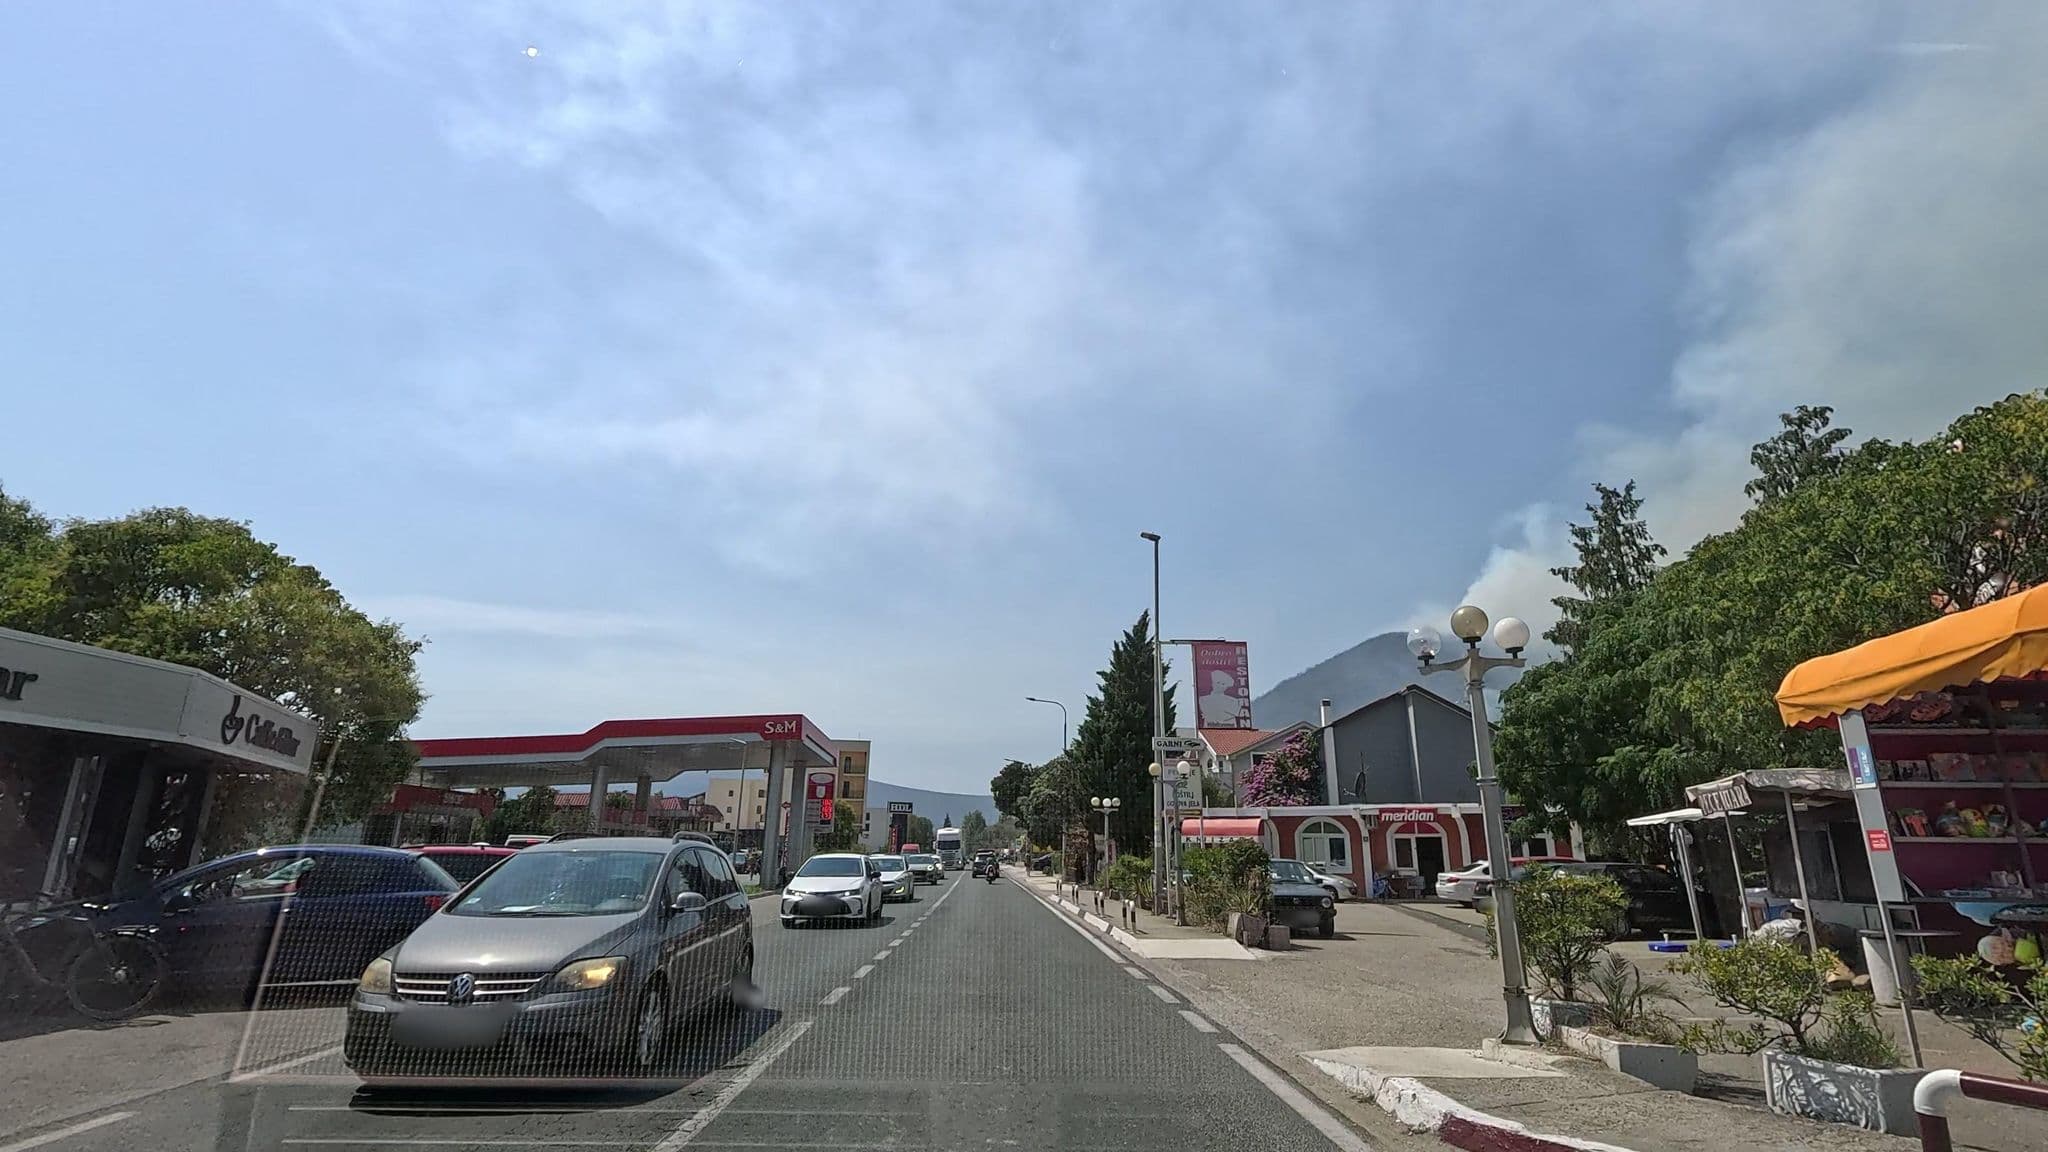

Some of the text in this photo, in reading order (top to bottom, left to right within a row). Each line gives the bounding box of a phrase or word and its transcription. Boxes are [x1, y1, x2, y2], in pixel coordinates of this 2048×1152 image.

[764, 720, 797, 734] S&M
[1176, 789, 1194, 799] OŠTILJ
[1381, 809, 1434, 821] meridian
